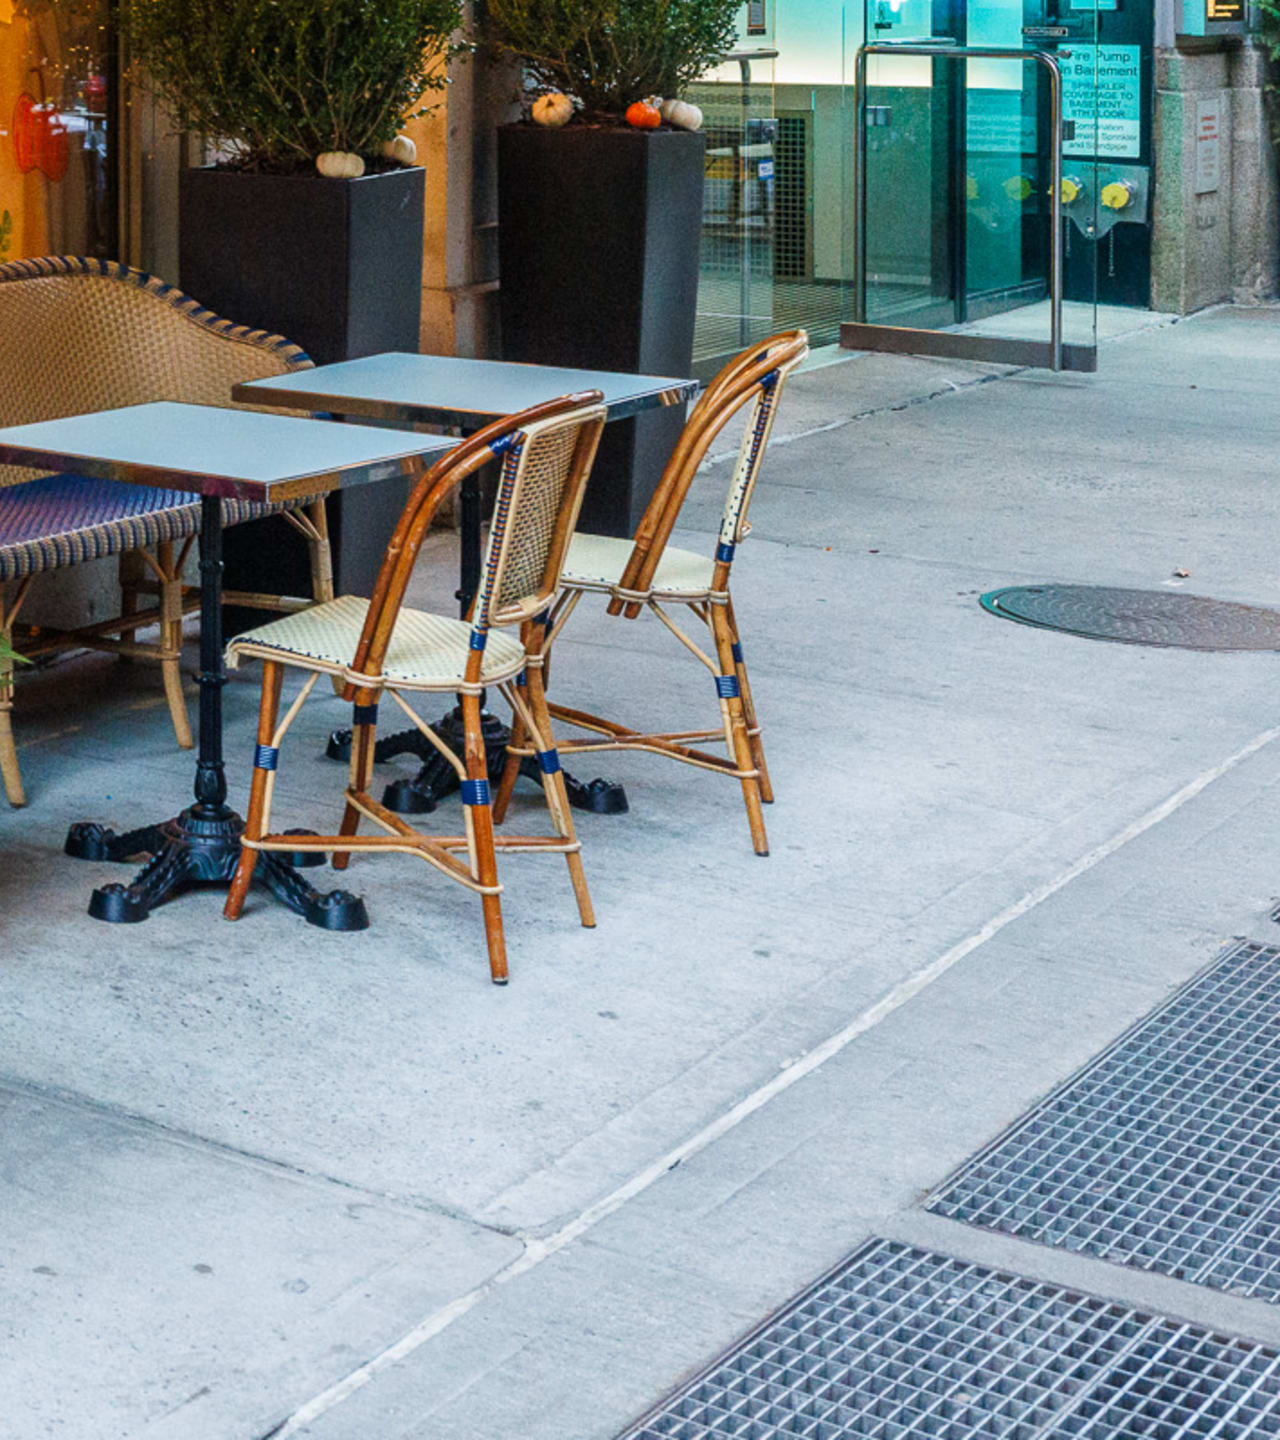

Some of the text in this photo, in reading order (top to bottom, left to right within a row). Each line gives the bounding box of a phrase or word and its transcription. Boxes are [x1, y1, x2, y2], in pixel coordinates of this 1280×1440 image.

[1096, 49, 1131, 64] Pump
[1074, 64, 1138, 77] Basement
[1075, 121, 1125, 131] Comination
[1085, 142, 1128, 151] Stndpipe
